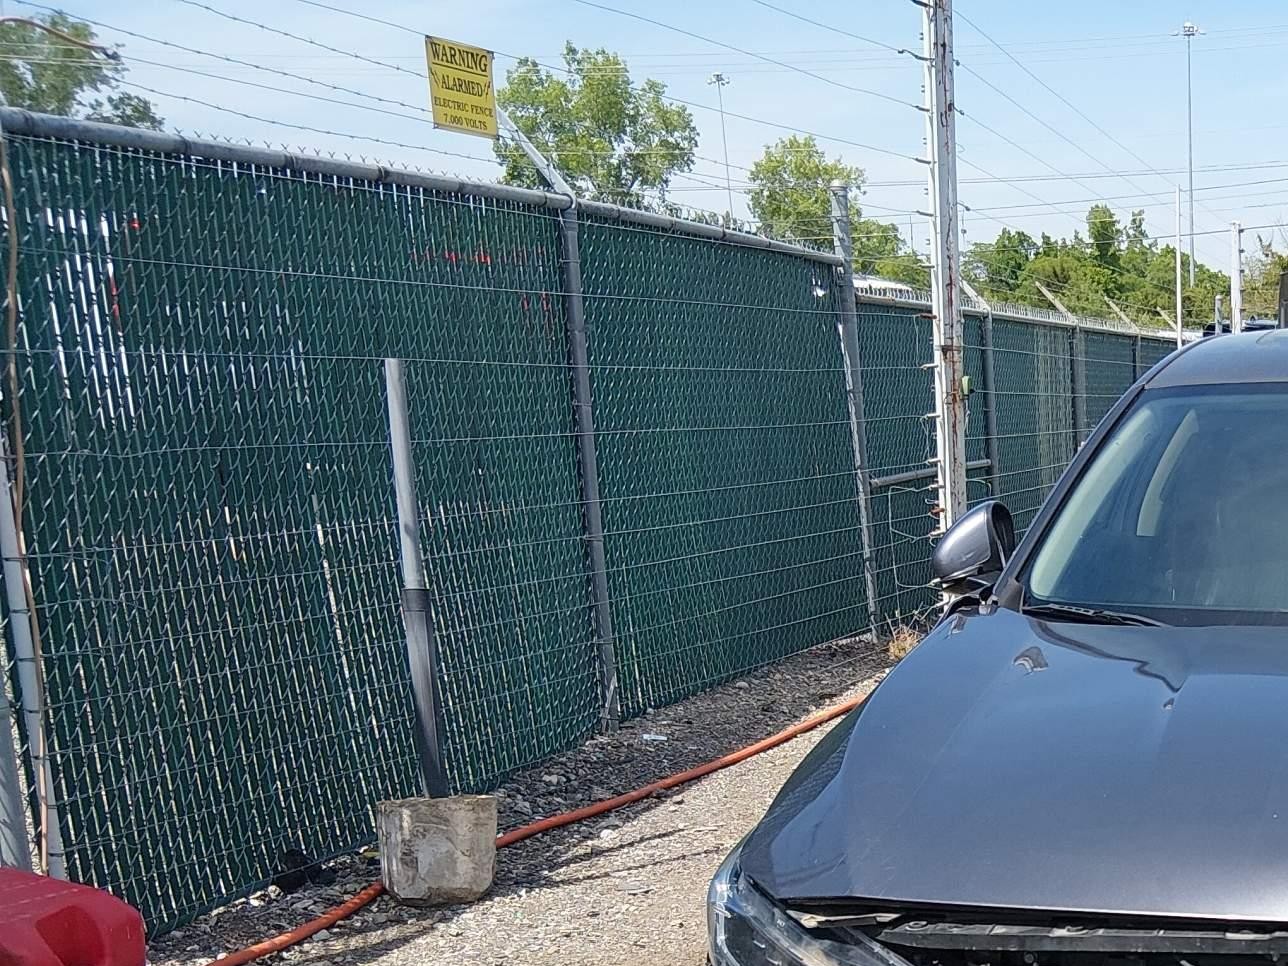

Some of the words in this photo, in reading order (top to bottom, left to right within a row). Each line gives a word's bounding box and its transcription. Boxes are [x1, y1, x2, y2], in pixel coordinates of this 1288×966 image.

[430, 42, 488, 72] WARNING
[441, 74, 483, 97] ALARMED
[433, 96, 469, 113] ELECTRIC
[470, 104, 494, 117] FENCE
[464, 117, 488, 130] VOLTS
